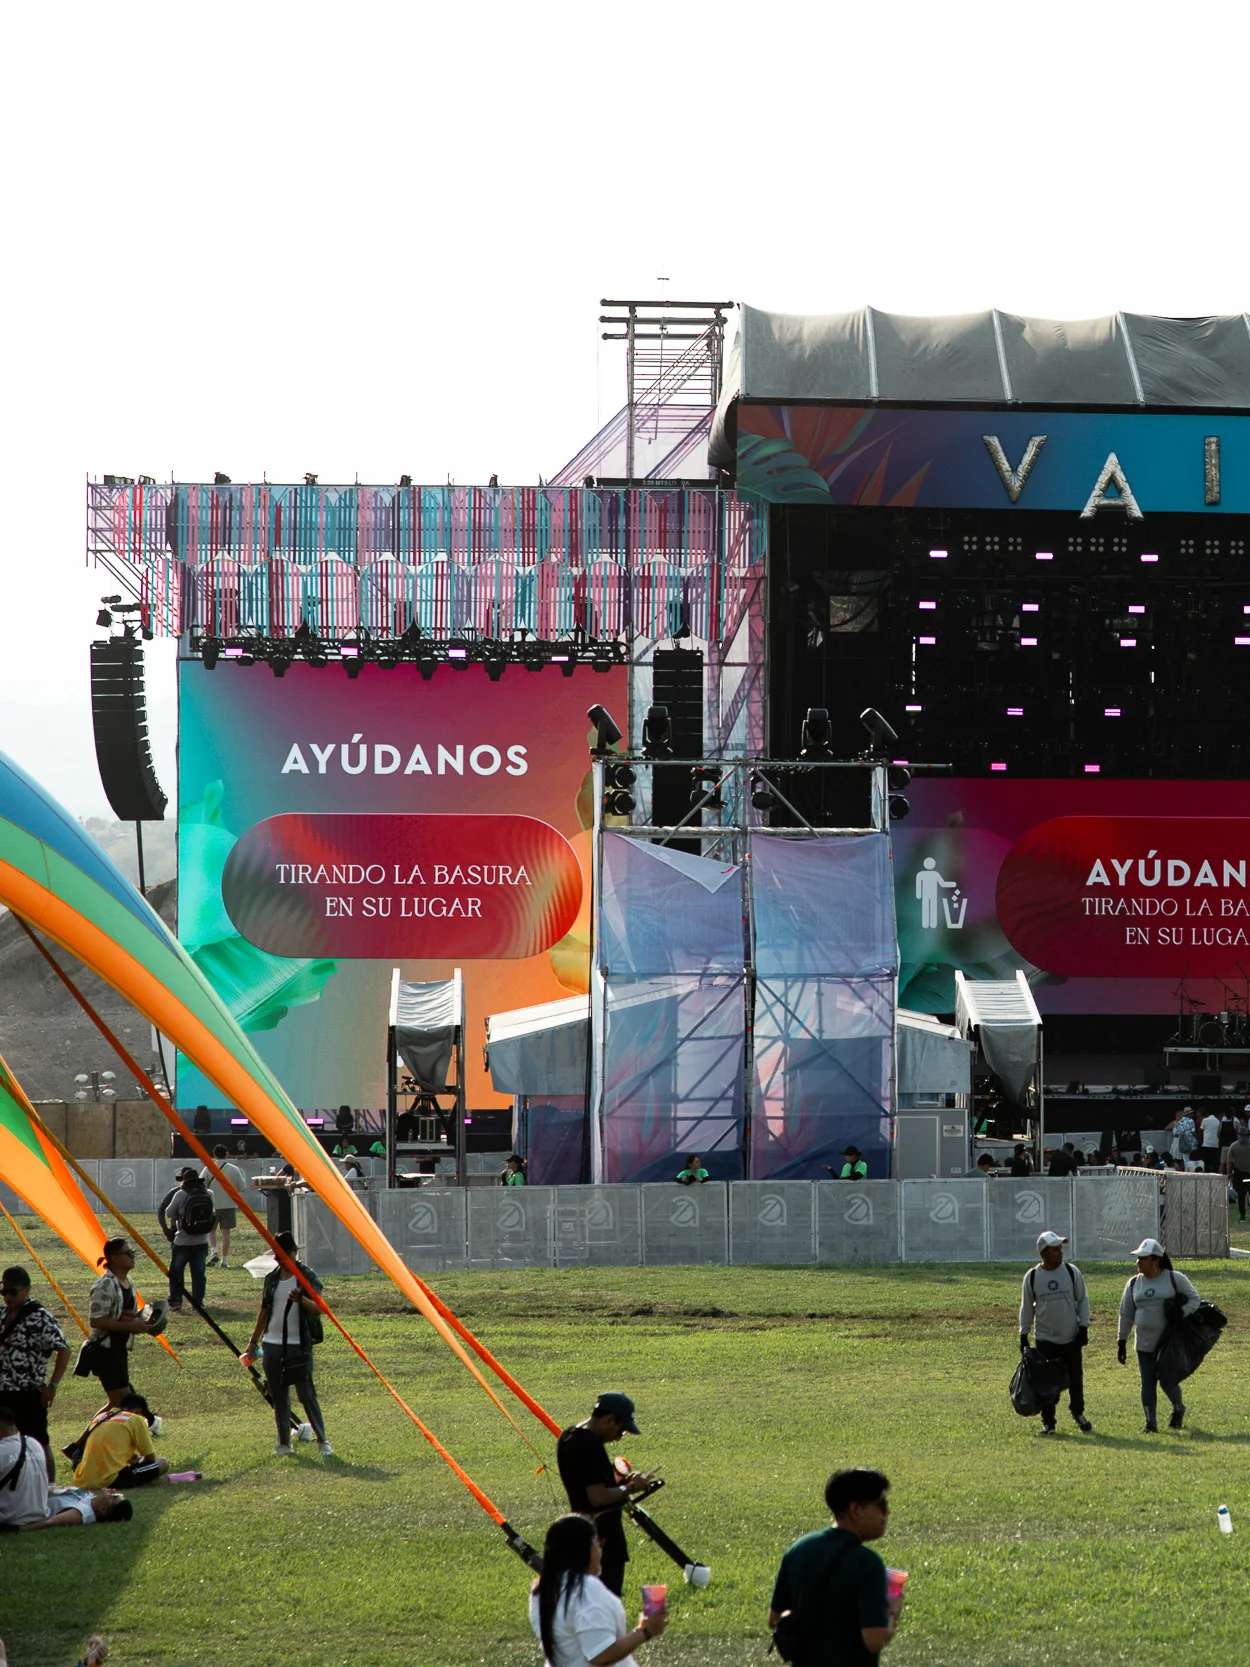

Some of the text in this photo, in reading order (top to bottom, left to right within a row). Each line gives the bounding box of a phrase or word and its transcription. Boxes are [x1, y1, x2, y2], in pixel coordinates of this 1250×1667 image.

[281, 734, 528, 776] AYÚDANOS
[276, 864, 532, 886] TIRANDO LA BASURA
[325, 897, 482, 918] EN SU LUGAR
[1082, 898, 1178, 916] TIRANDO
[1185, 899, 1214, 916] LA
[1125, 927, 1150, 946] EN
[1158, 927, 1184, 946] SU
